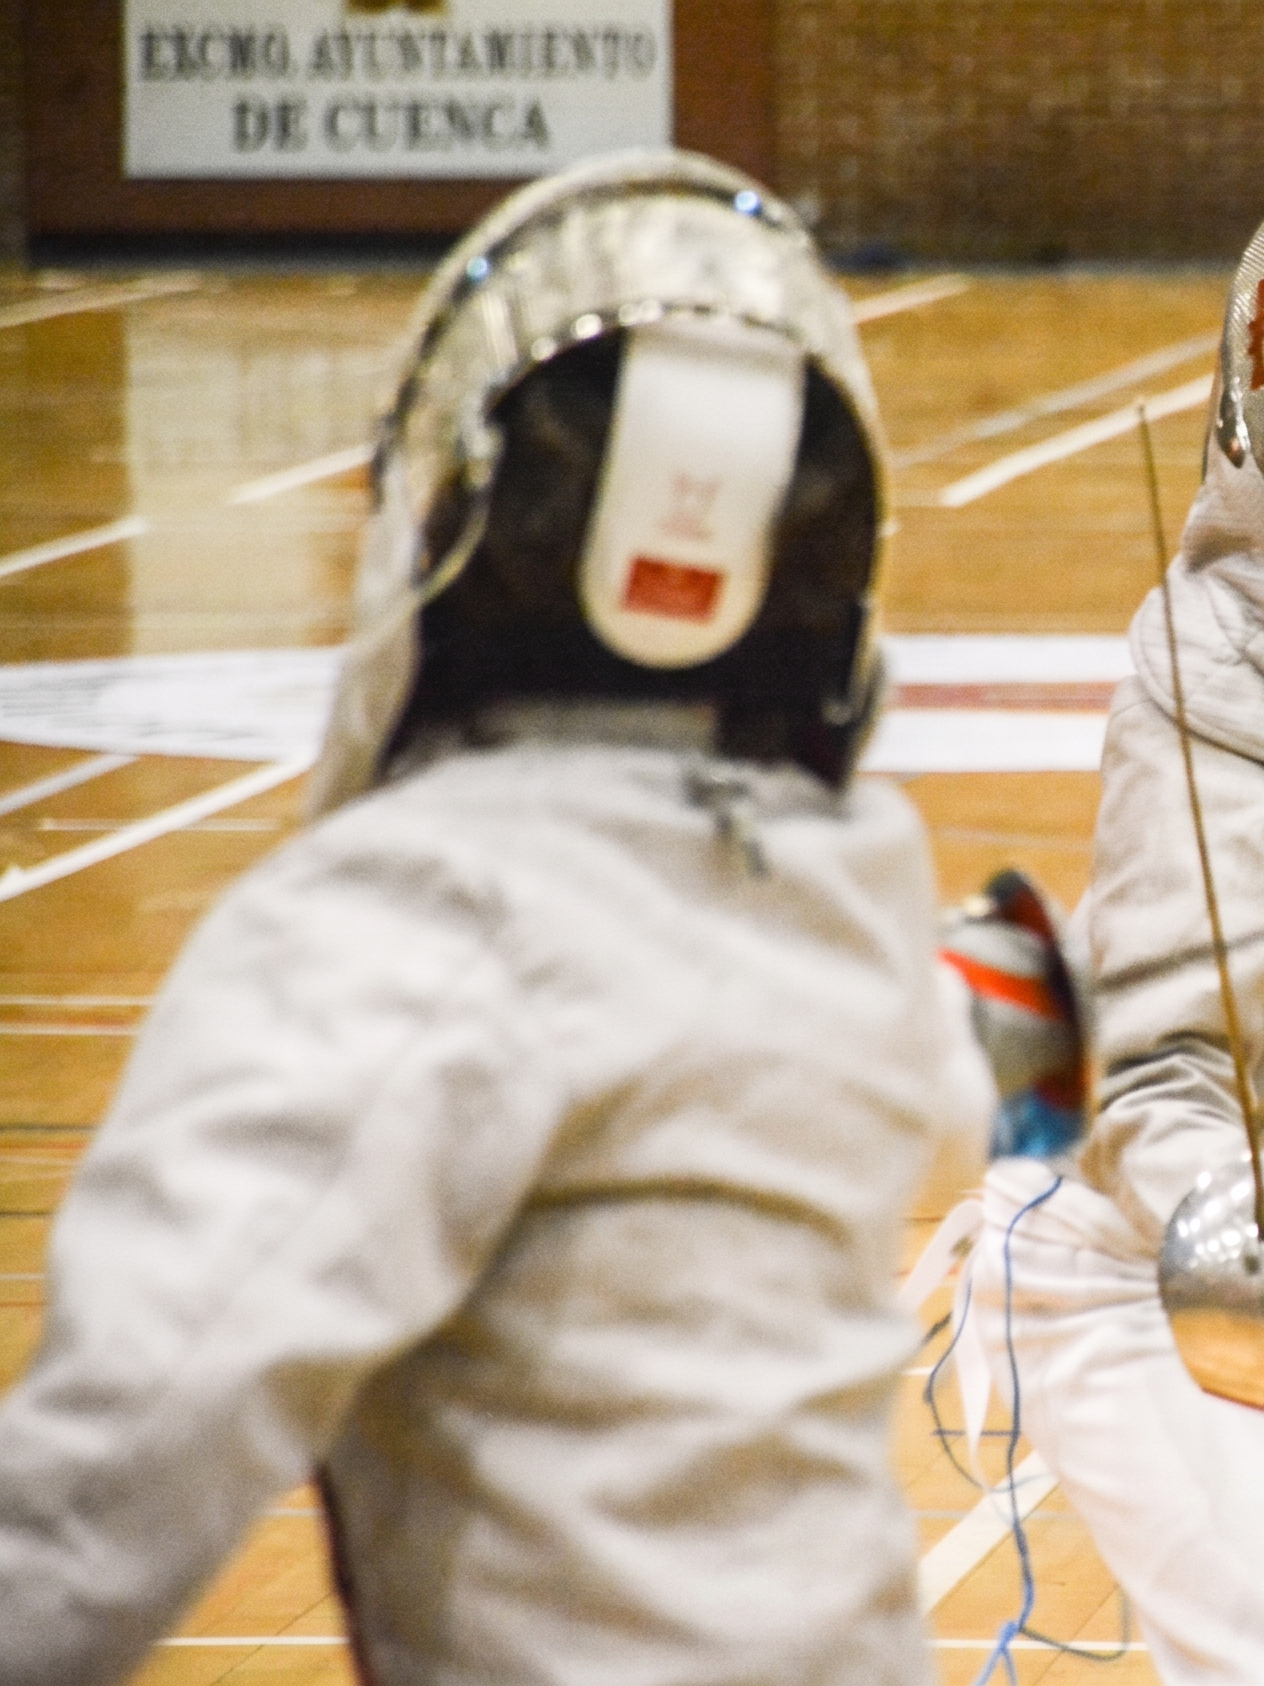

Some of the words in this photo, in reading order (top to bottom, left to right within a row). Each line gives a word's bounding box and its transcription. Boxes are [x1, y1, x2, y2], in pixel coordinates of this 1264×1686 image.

[305, 25, 658, 80] AYUNTAMIENTO
[233, 96, 307, 152] DE
[322, 96, 551, 152] CUENCA
